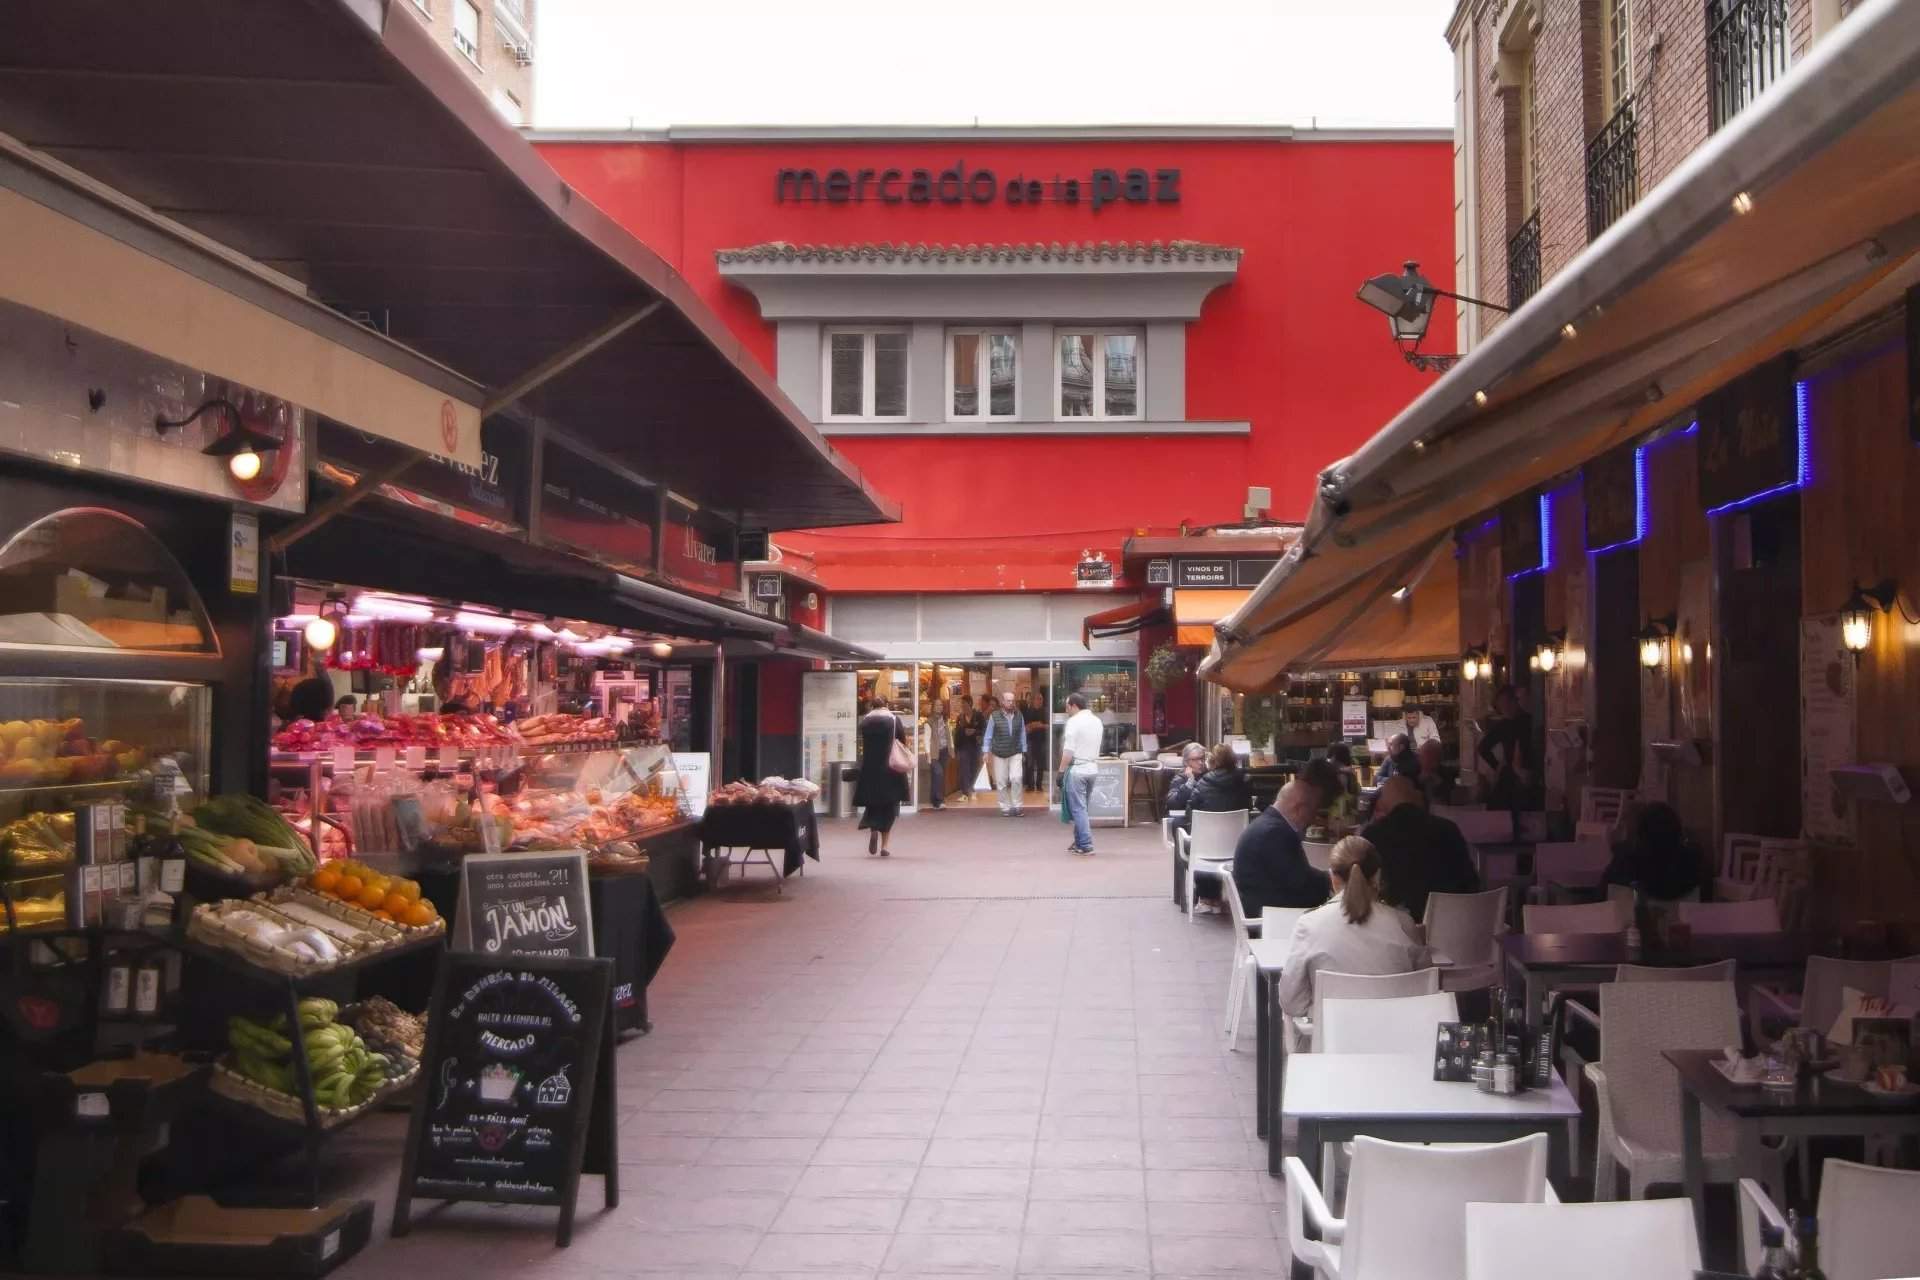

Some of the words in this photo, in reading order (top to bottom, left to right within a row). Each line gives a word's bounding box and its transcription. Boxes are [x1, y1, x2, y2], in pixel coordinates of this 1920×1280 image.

[775, 159, 998, 205] mercado
[1005, 172, 1044, 204] de
[1054, 172, 1081, 204] la
[1091, 166, 1182, 212] paz
[1186, 565, 1211, 573] VINOS
[1213, 565, 1224, 573] DE
[1186, 574, 1225, 582] TERROIRS
[481, 1029, 535, 1051] MERCADO
